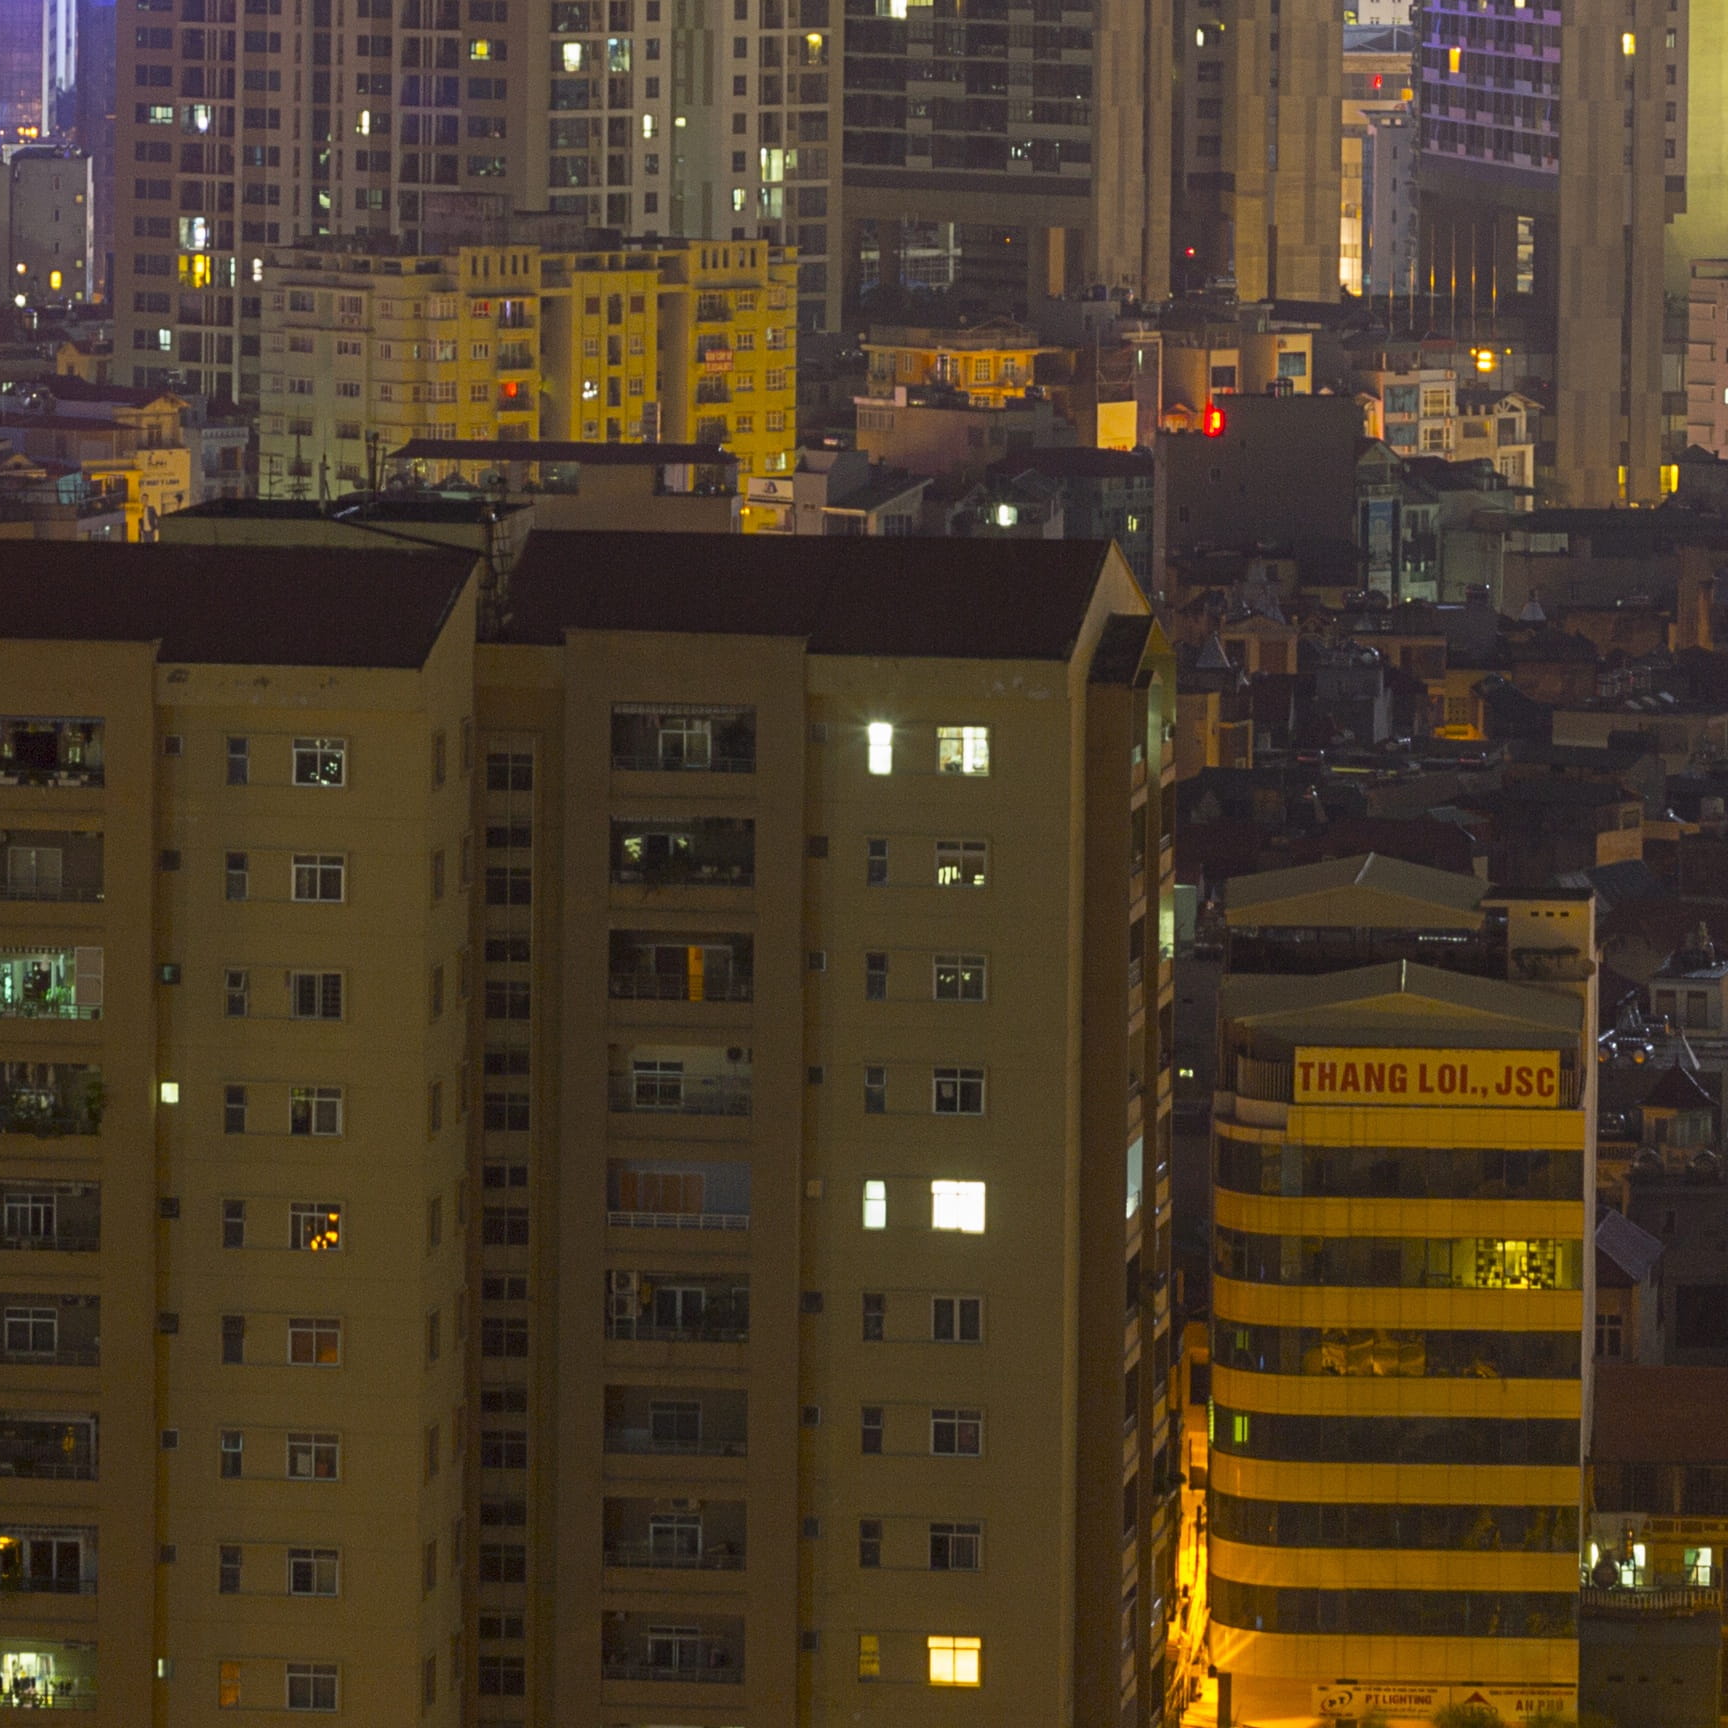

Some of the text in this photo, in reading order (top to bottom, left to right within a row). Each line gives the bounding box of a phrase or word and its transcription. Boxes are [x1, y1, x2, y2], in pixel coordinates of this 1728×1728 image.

[1298, 1061, 1408, 1094] THANG
[1494, 1065, 1556, 1098] JSC
[1364, 1693, 1433, 1706] PT LIGHTING
[1515, 1698, 1534, 1711] AN
